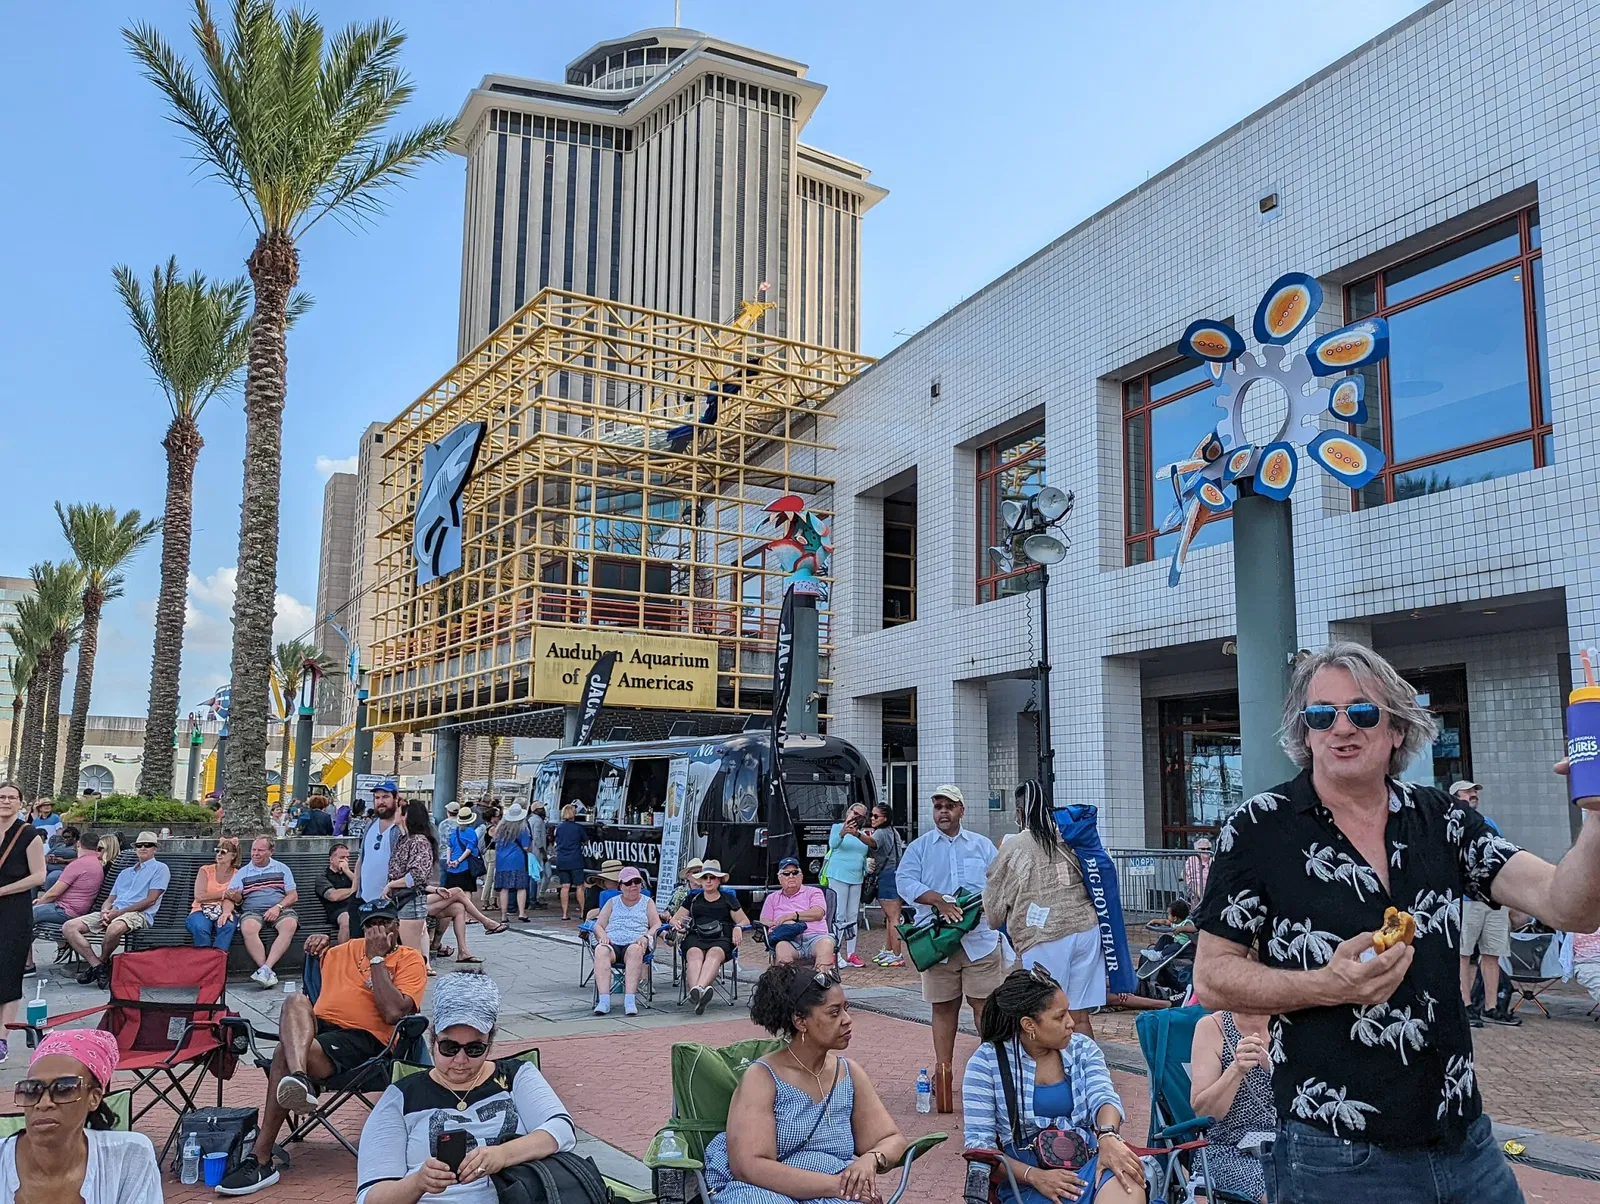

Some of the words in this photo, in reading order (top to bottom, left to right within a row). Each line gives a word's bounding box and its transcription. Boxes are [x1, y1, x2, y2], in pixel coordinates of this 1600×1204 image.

[546, 643, 623, 663] Audubn
[629, 649, 710, 670] Aquarium
[562, 668, 580, 685] of
[617, 672, 694, 692] Americas
[584, 674, 607, 720] JACK
[1084, 857, 1101, 885] BIG
[1092, 887, 1110, 919] BOY
[1099, 922, 1119, 972] CHAIR
